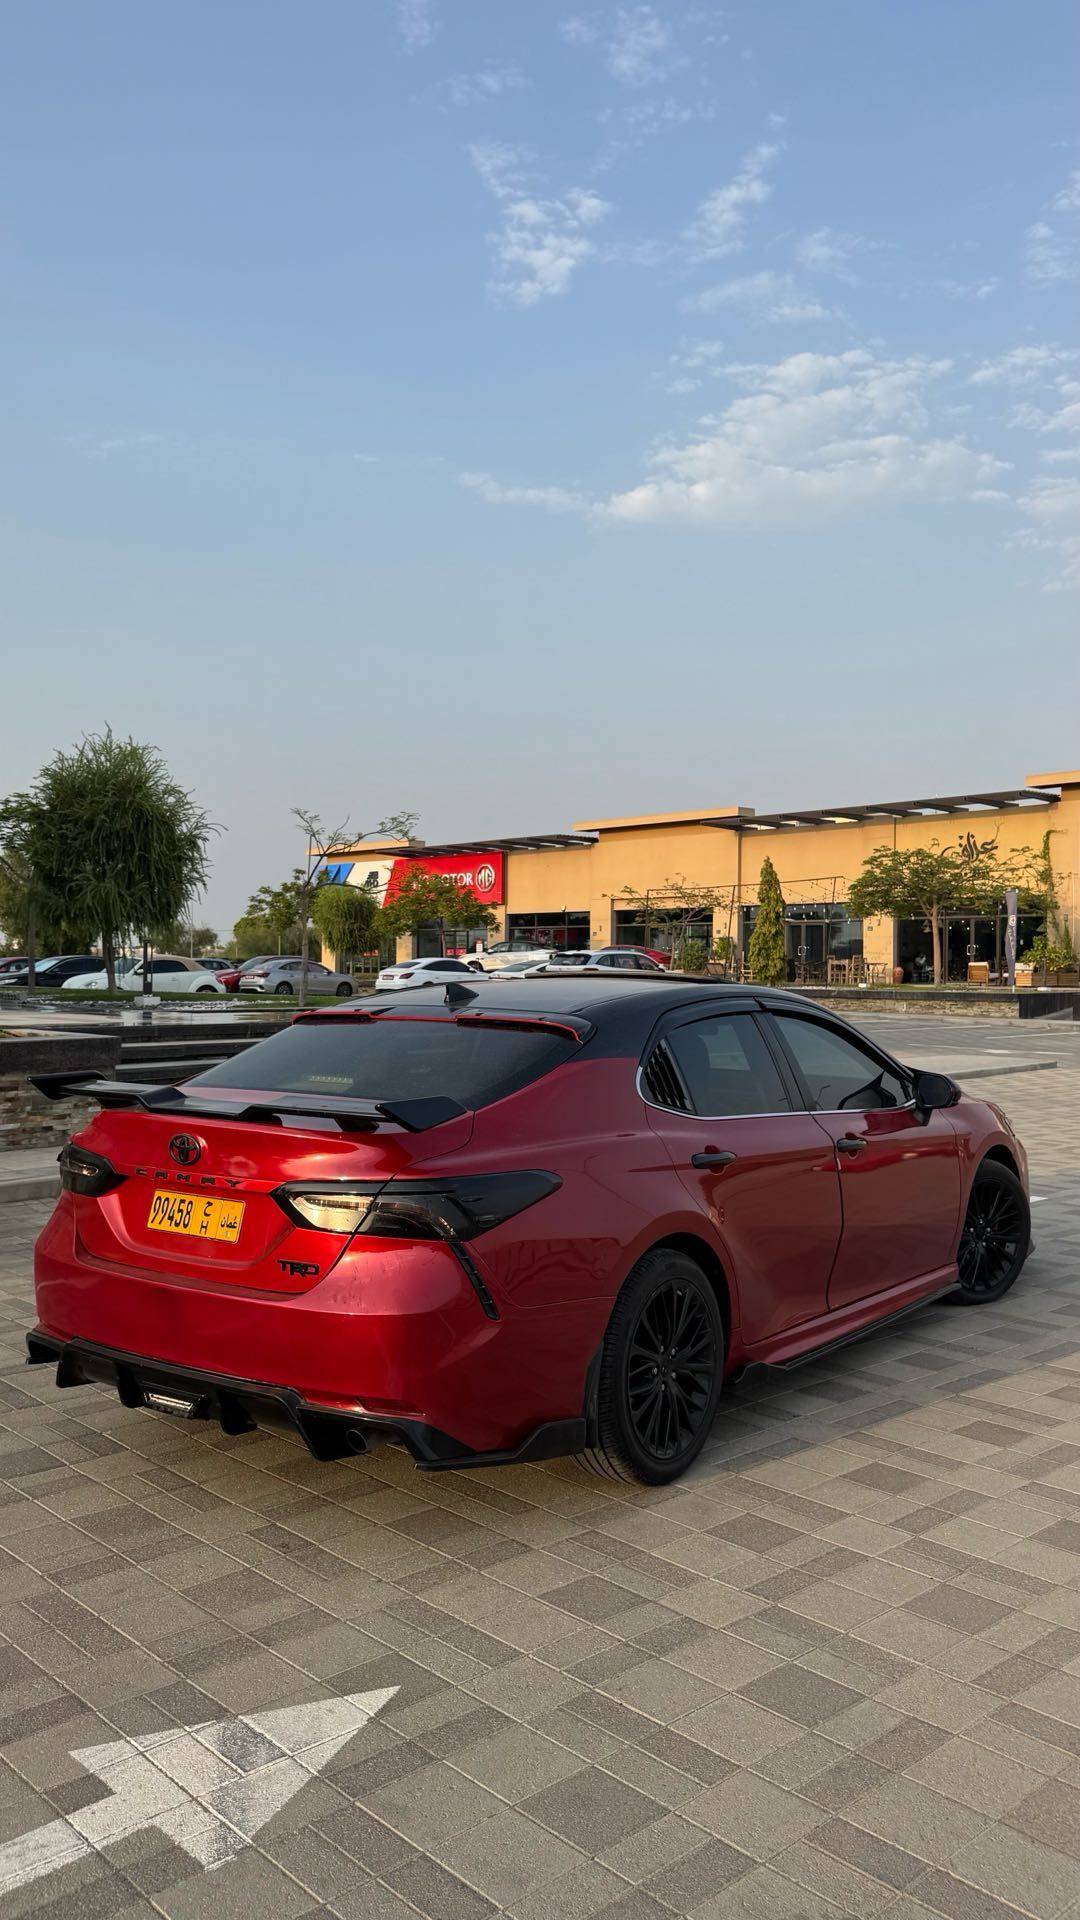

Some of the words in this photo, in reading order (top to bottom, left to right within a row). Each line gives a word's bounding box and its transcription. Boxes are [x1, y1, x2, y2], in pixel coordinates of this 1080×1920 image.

[431, 873, 474, 887] OTOR
[478, 867, 493, 889] MG
[136, 1167, 246, 1188] CAMRY
[151, 1195, 193, 1229] 99458
[199, 1220, 209, 1235] H
[277, 1259, 319, 1278] TRD
